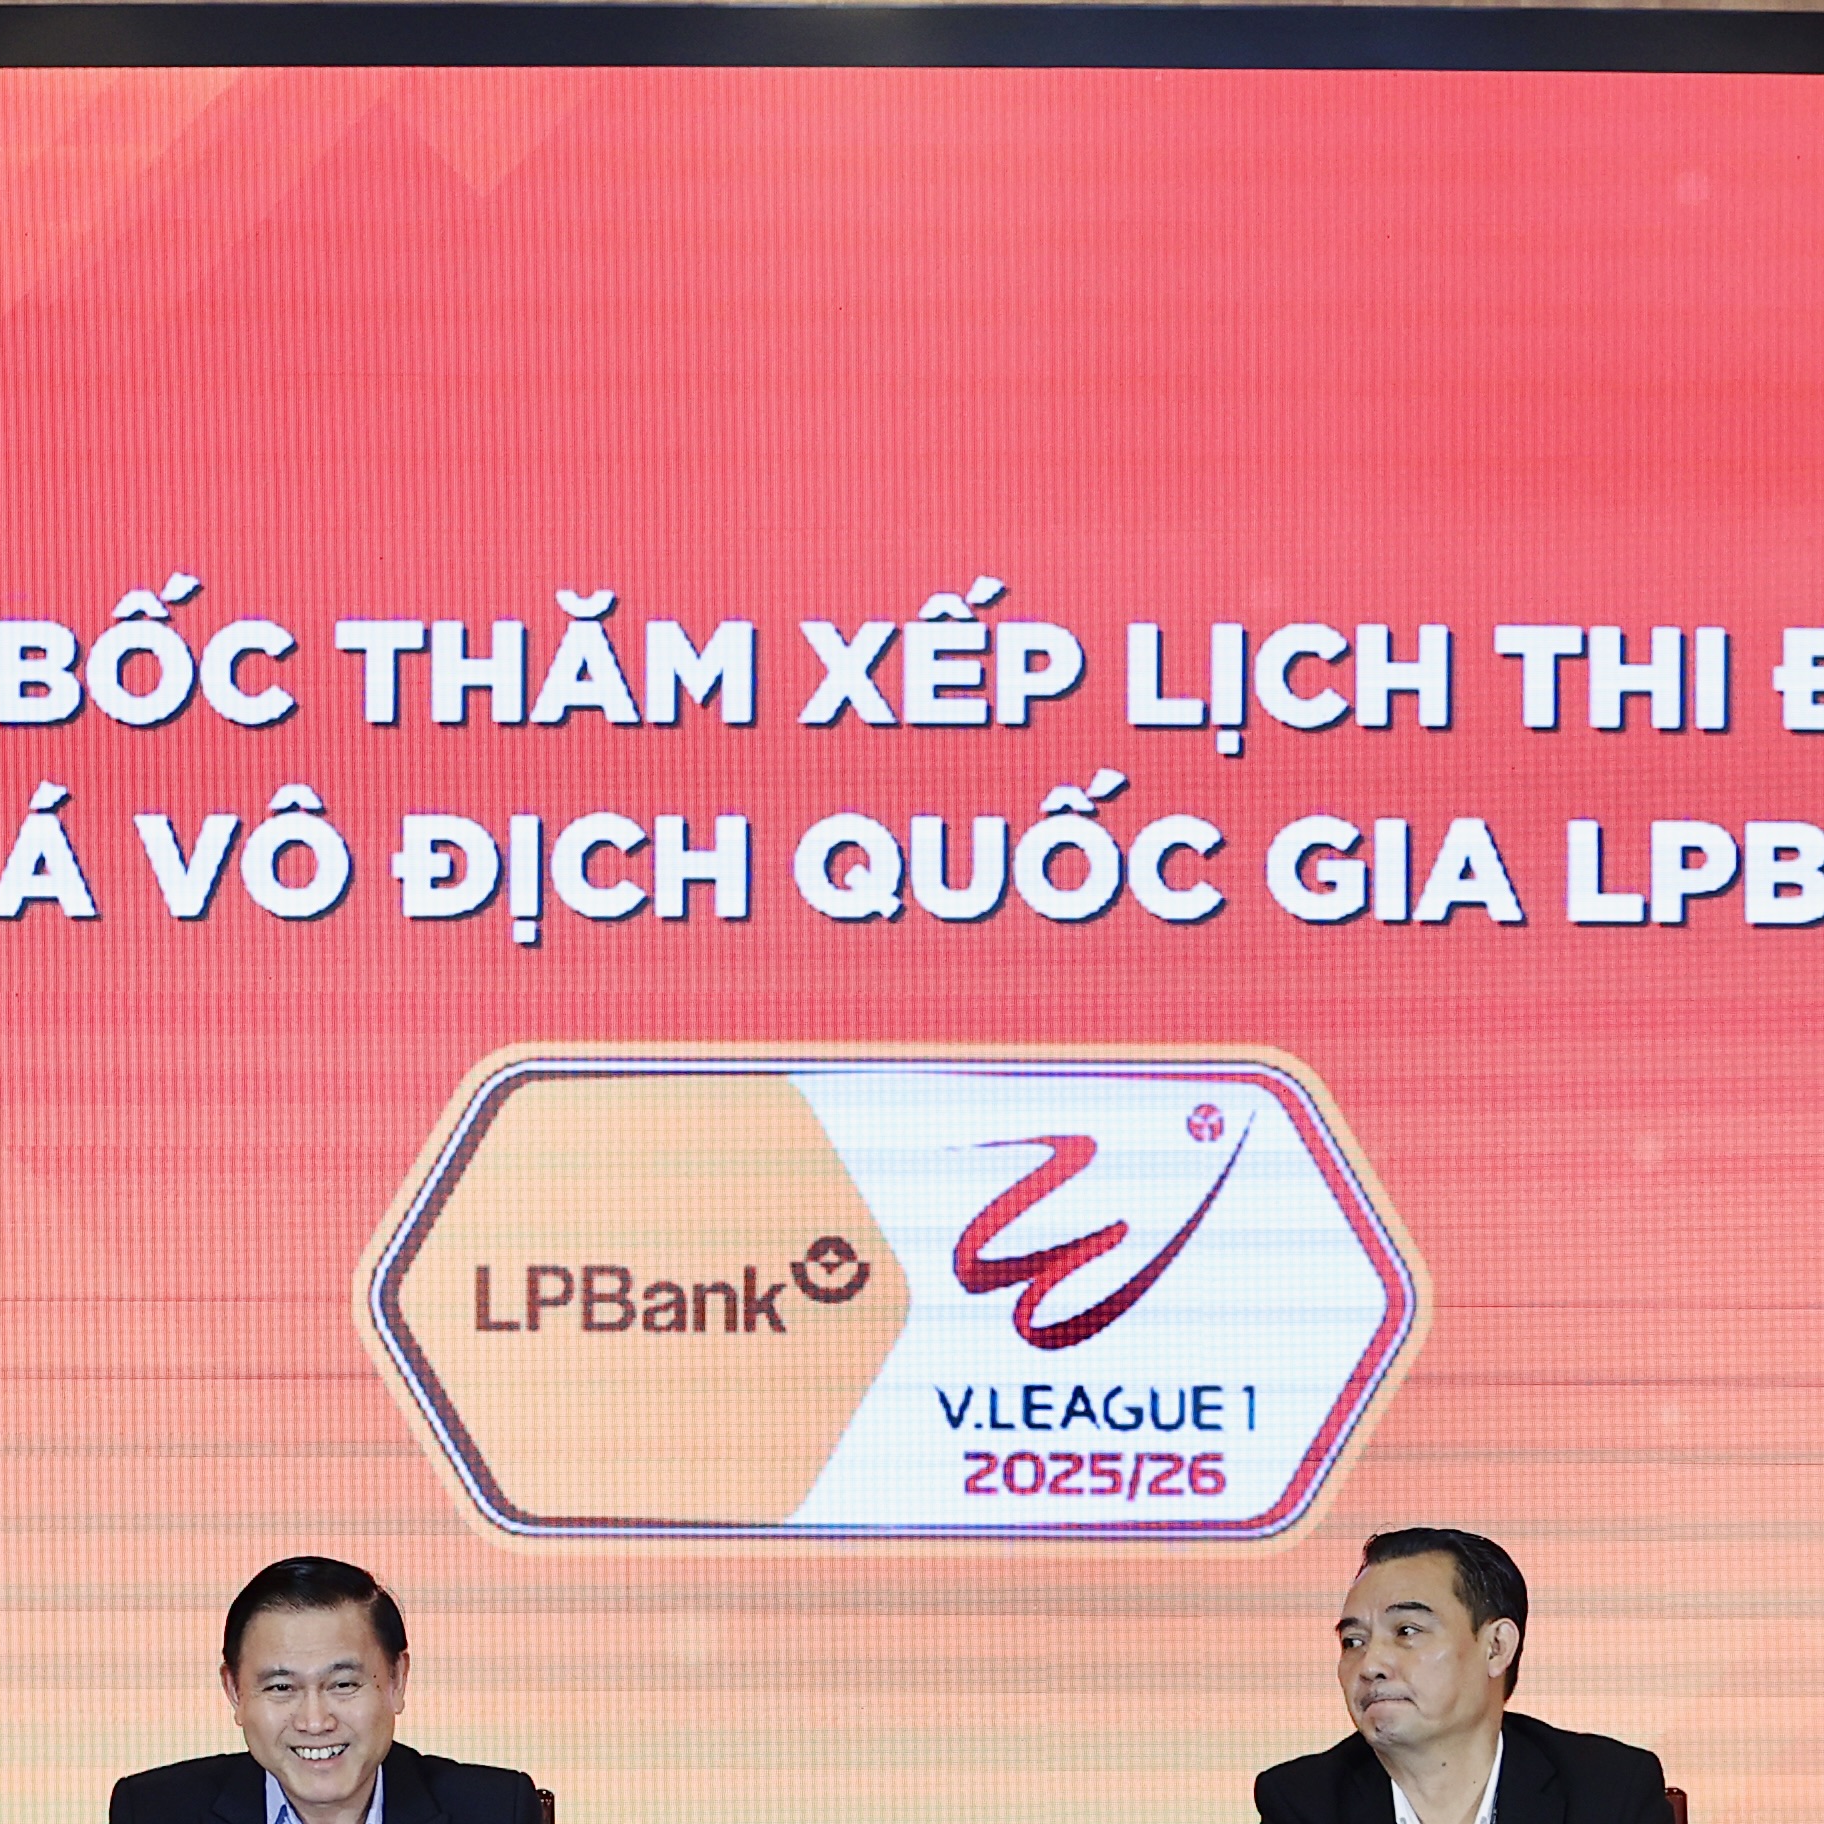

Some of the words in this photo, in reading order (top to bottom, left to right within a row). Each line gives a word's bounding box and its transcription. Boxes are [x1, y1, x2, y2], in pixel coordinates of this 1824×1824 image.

[335, 589, 755, 726] THĂM
[799, 576, 1084, 727] XẾP
[1127, 622, 1451, 755] LỊCH
[1495, 625, 1728, 732] THI
[134, 784, 352, 919] VÔ
[392, 812, 750, 945] ĐỊCH
[794, 769, 1224, 921] QUỐC
[1267, 816, 1525, 923] GIA
[474, 1264, 789, 1334] LPBank
[936, 1383, 1226, 1433] V.LEAGUE
[1240, 1384, 1256, 1431] 1
[963, 1449, 1228, 1502] 2025/26
